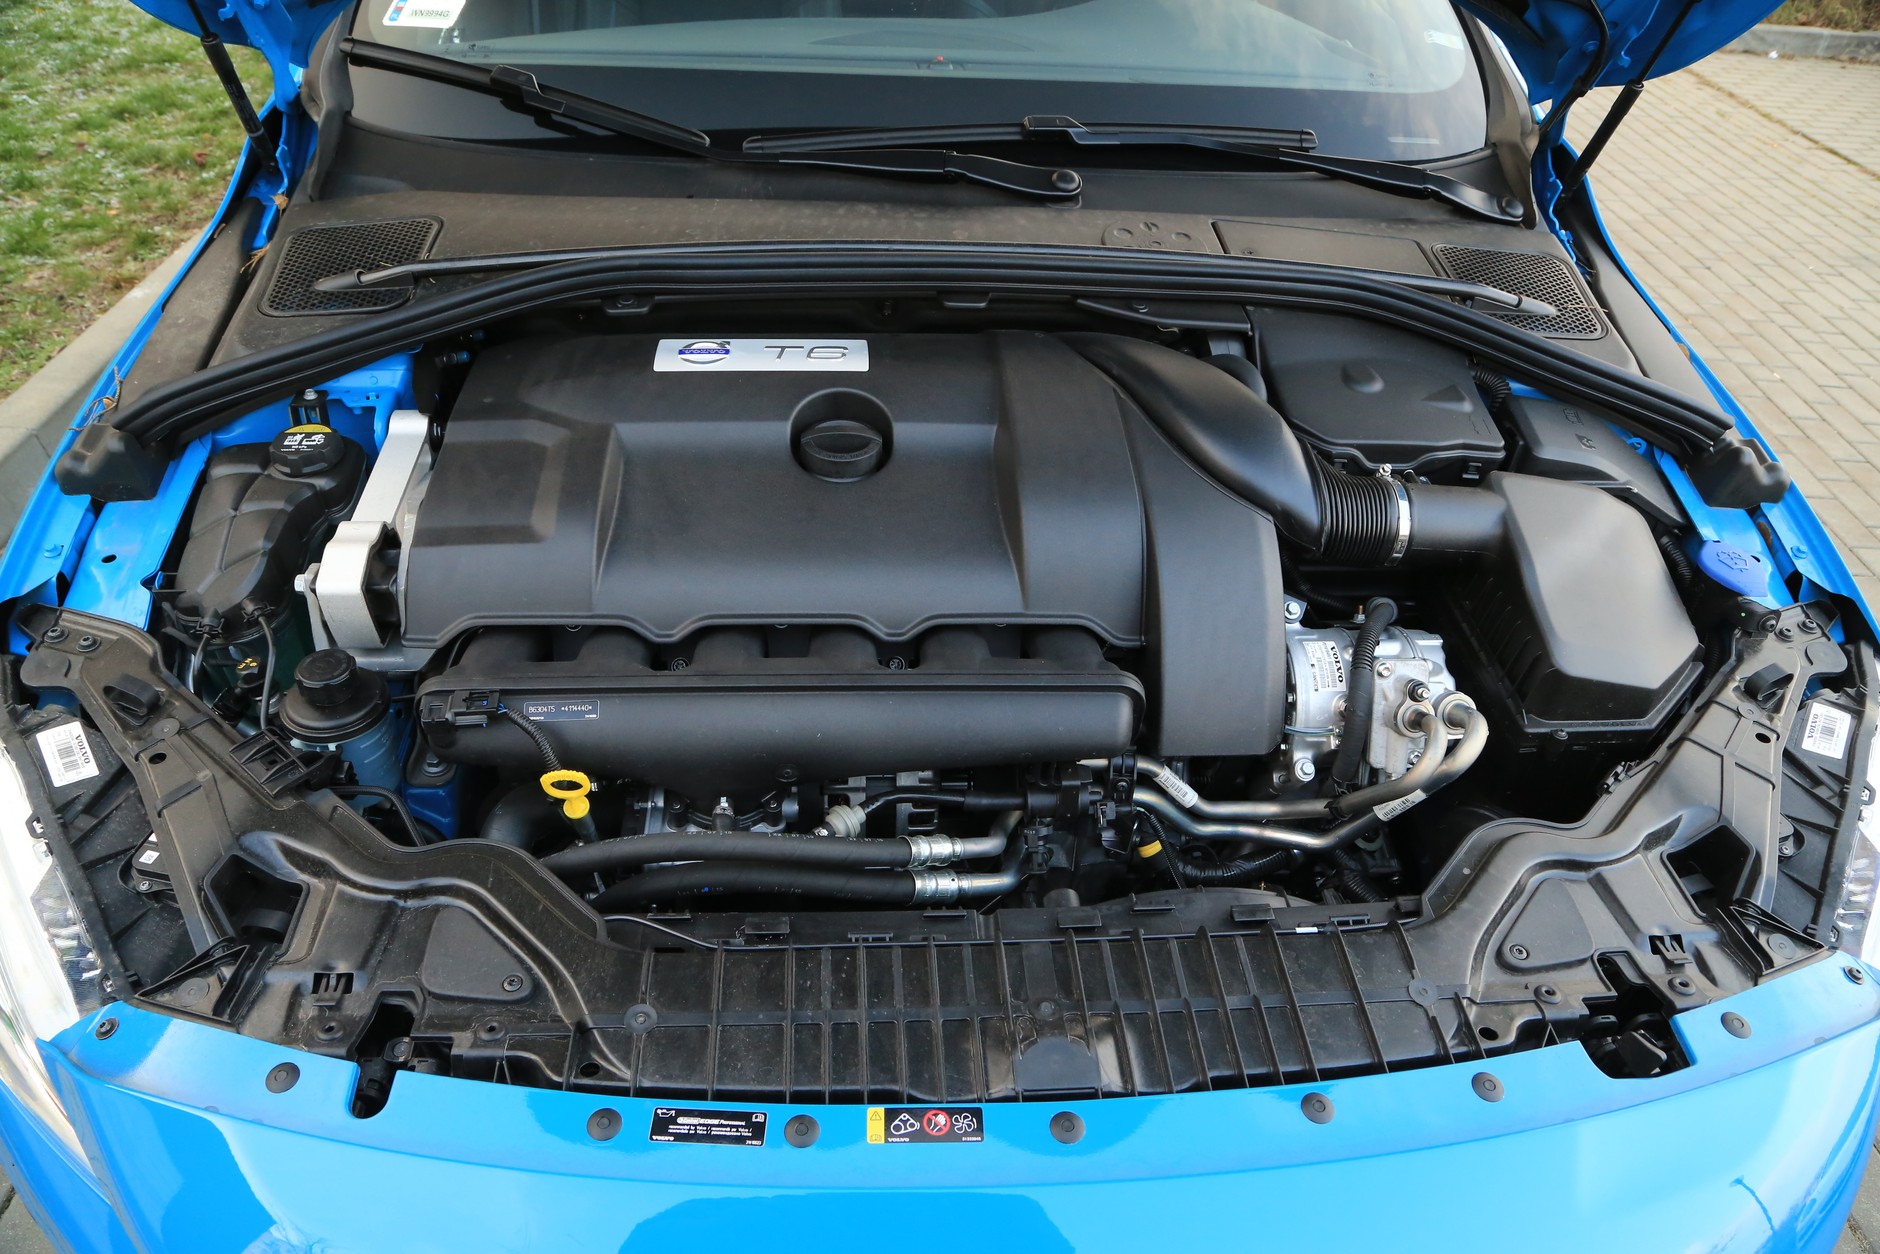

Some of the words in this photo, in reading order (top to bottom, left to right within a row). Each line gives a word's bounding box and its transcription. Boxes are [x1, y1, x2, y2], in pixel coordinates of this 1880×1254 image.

[764, 346, 849, 361] T6
[1330, 646, 1344, 683] VOLVO
[1807, 713, 1819, 739] VOLVO
[75, 734, 91, 764] VOLVO
